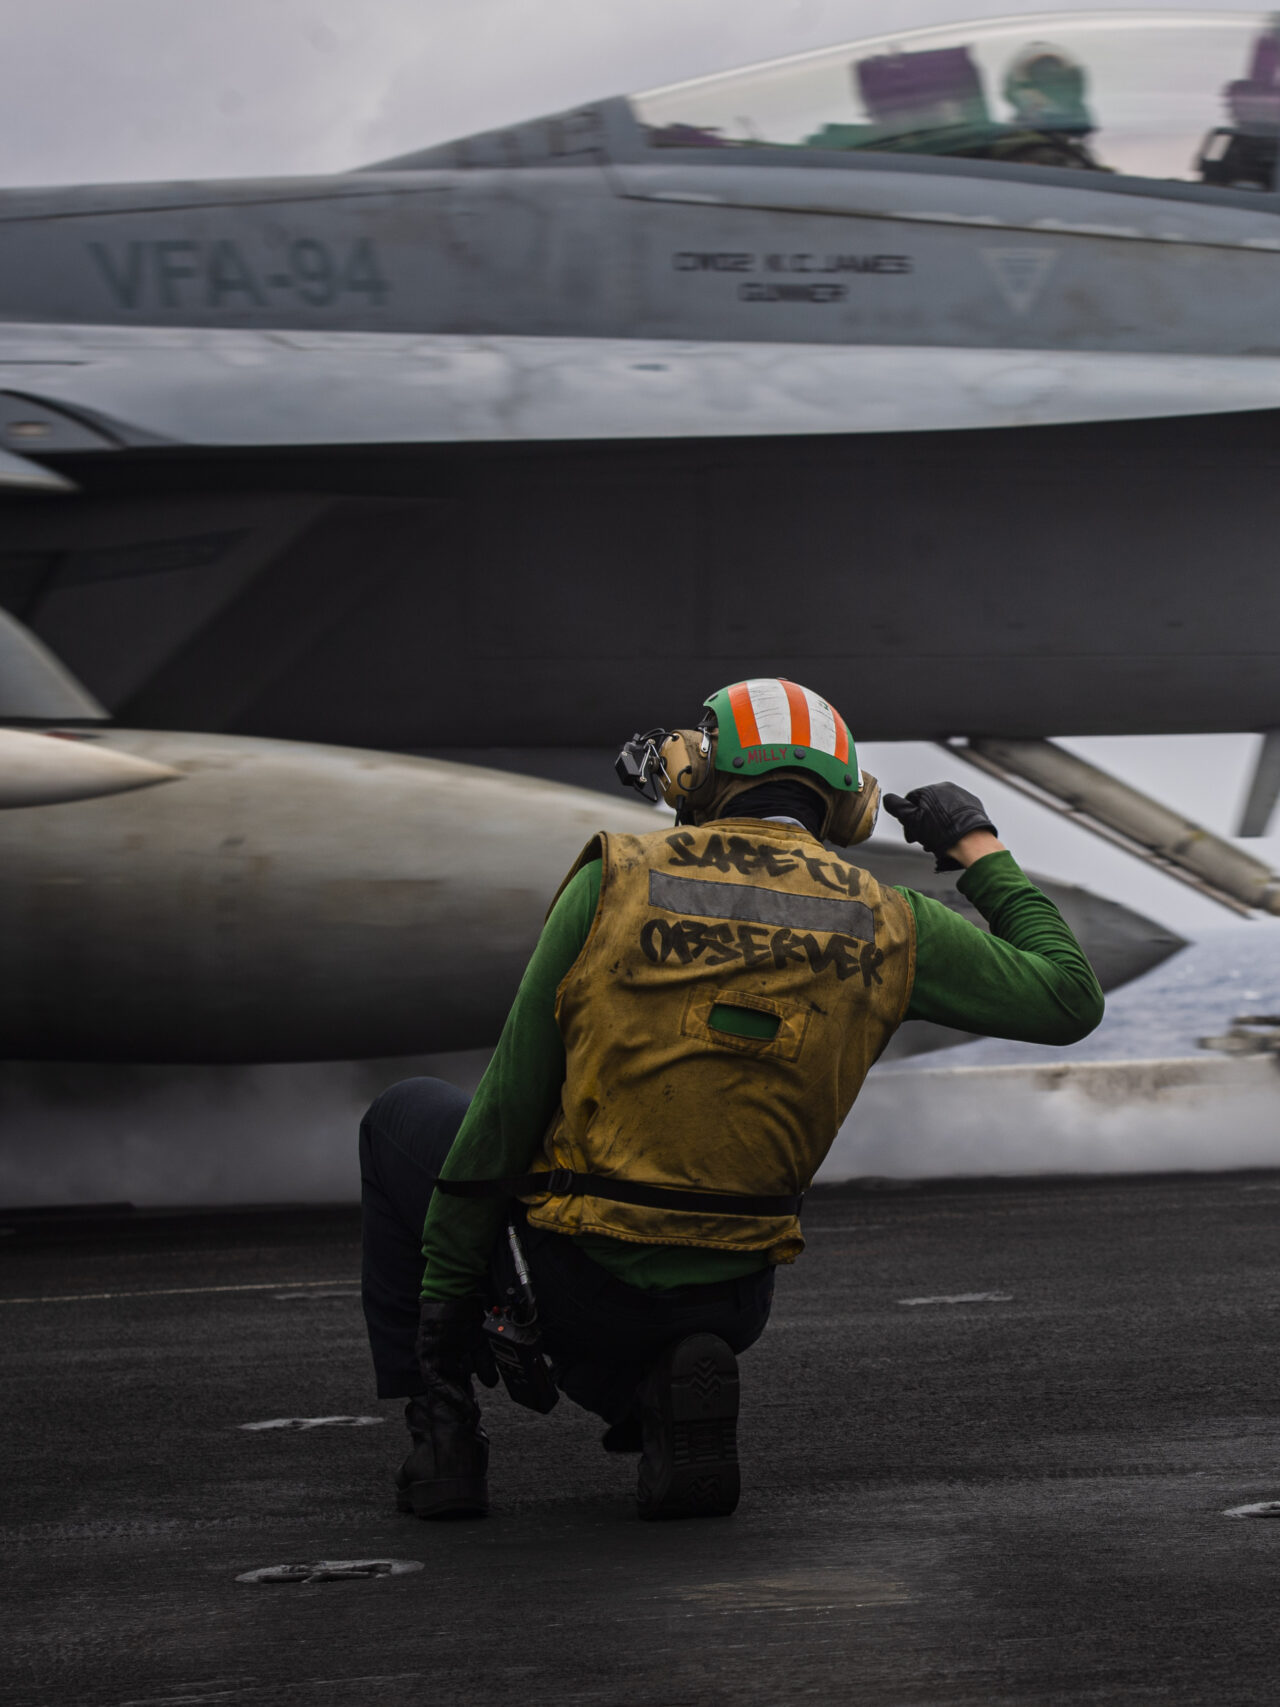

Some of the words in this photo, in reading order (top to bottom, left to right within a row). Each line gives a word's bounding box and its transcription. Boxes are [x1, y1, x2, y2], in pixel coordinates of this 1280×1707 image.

[85, 237, 392, 308] VFA-94
[747, 748, 787, 764] MILLY
[665, 832, 861, 896] SAFETY
[640, 919, 885, 987] OBSERVER
